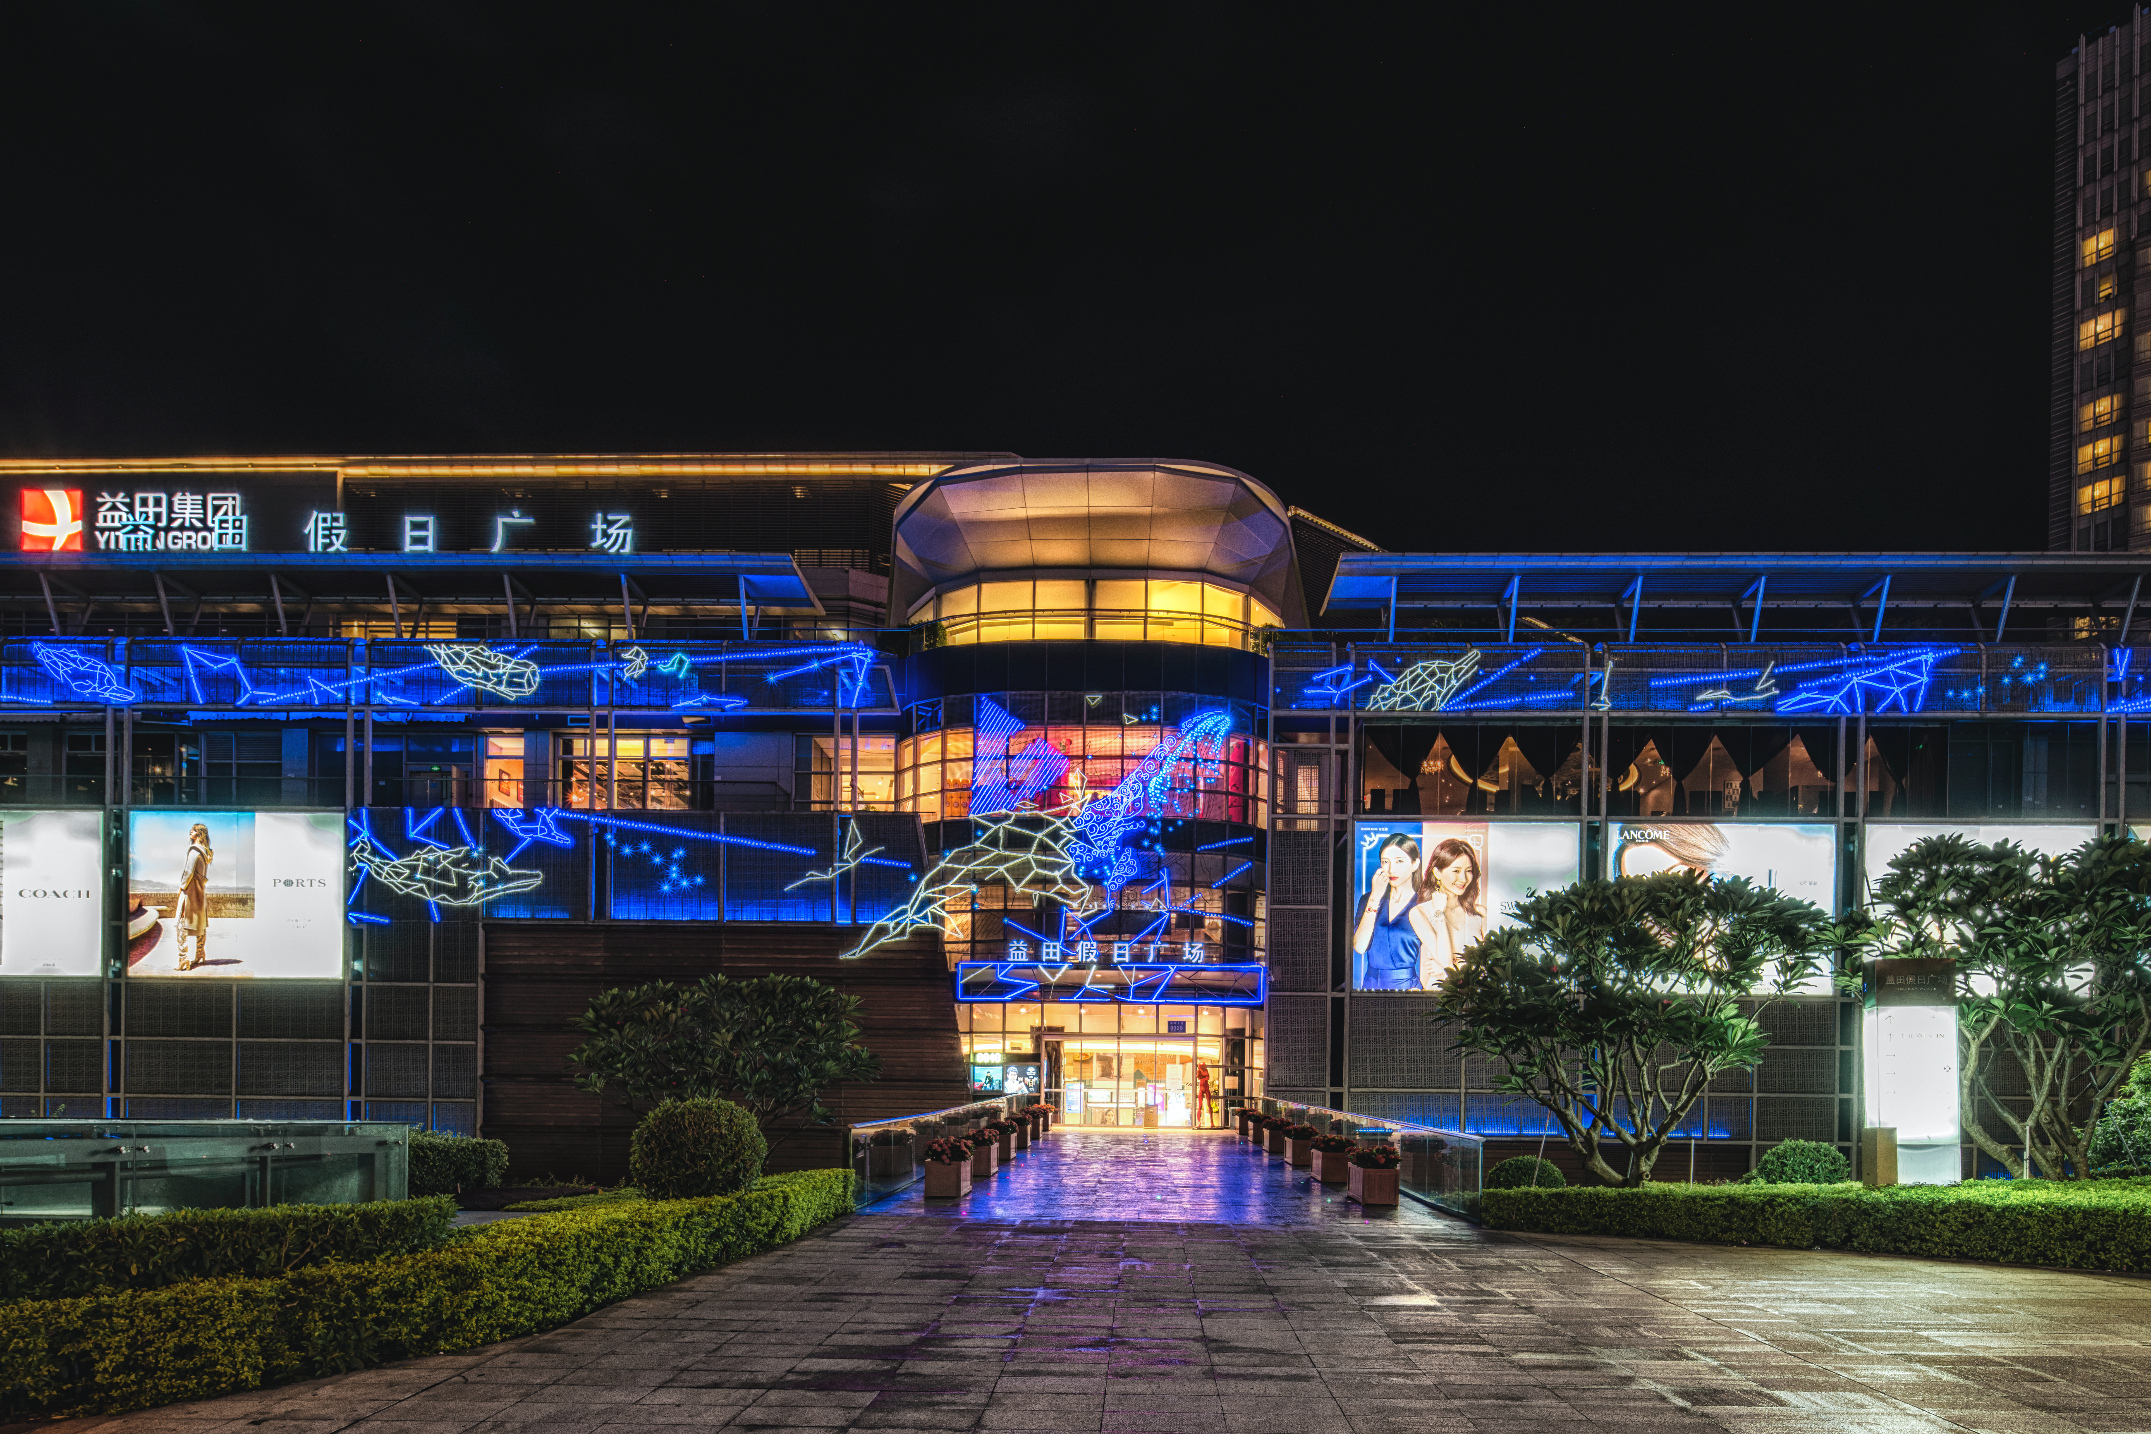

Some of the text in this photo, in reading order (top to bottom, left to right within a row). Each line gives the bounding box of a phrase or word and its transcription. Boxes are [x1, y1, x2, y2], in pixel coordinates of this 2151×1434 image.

[95, 492, 241, 527] 益田集团
[119, 510, 633, 552] 益田假日广场
[1616, 828, 1670, 840] LANCÔME
[272, 878, 327, 888] PORTS
[18, 888, 90, 899] COACH
[1008, 940, 1205, 963] 益田假日广场
[1885, 974, 1948, 985] 益田假日广场
